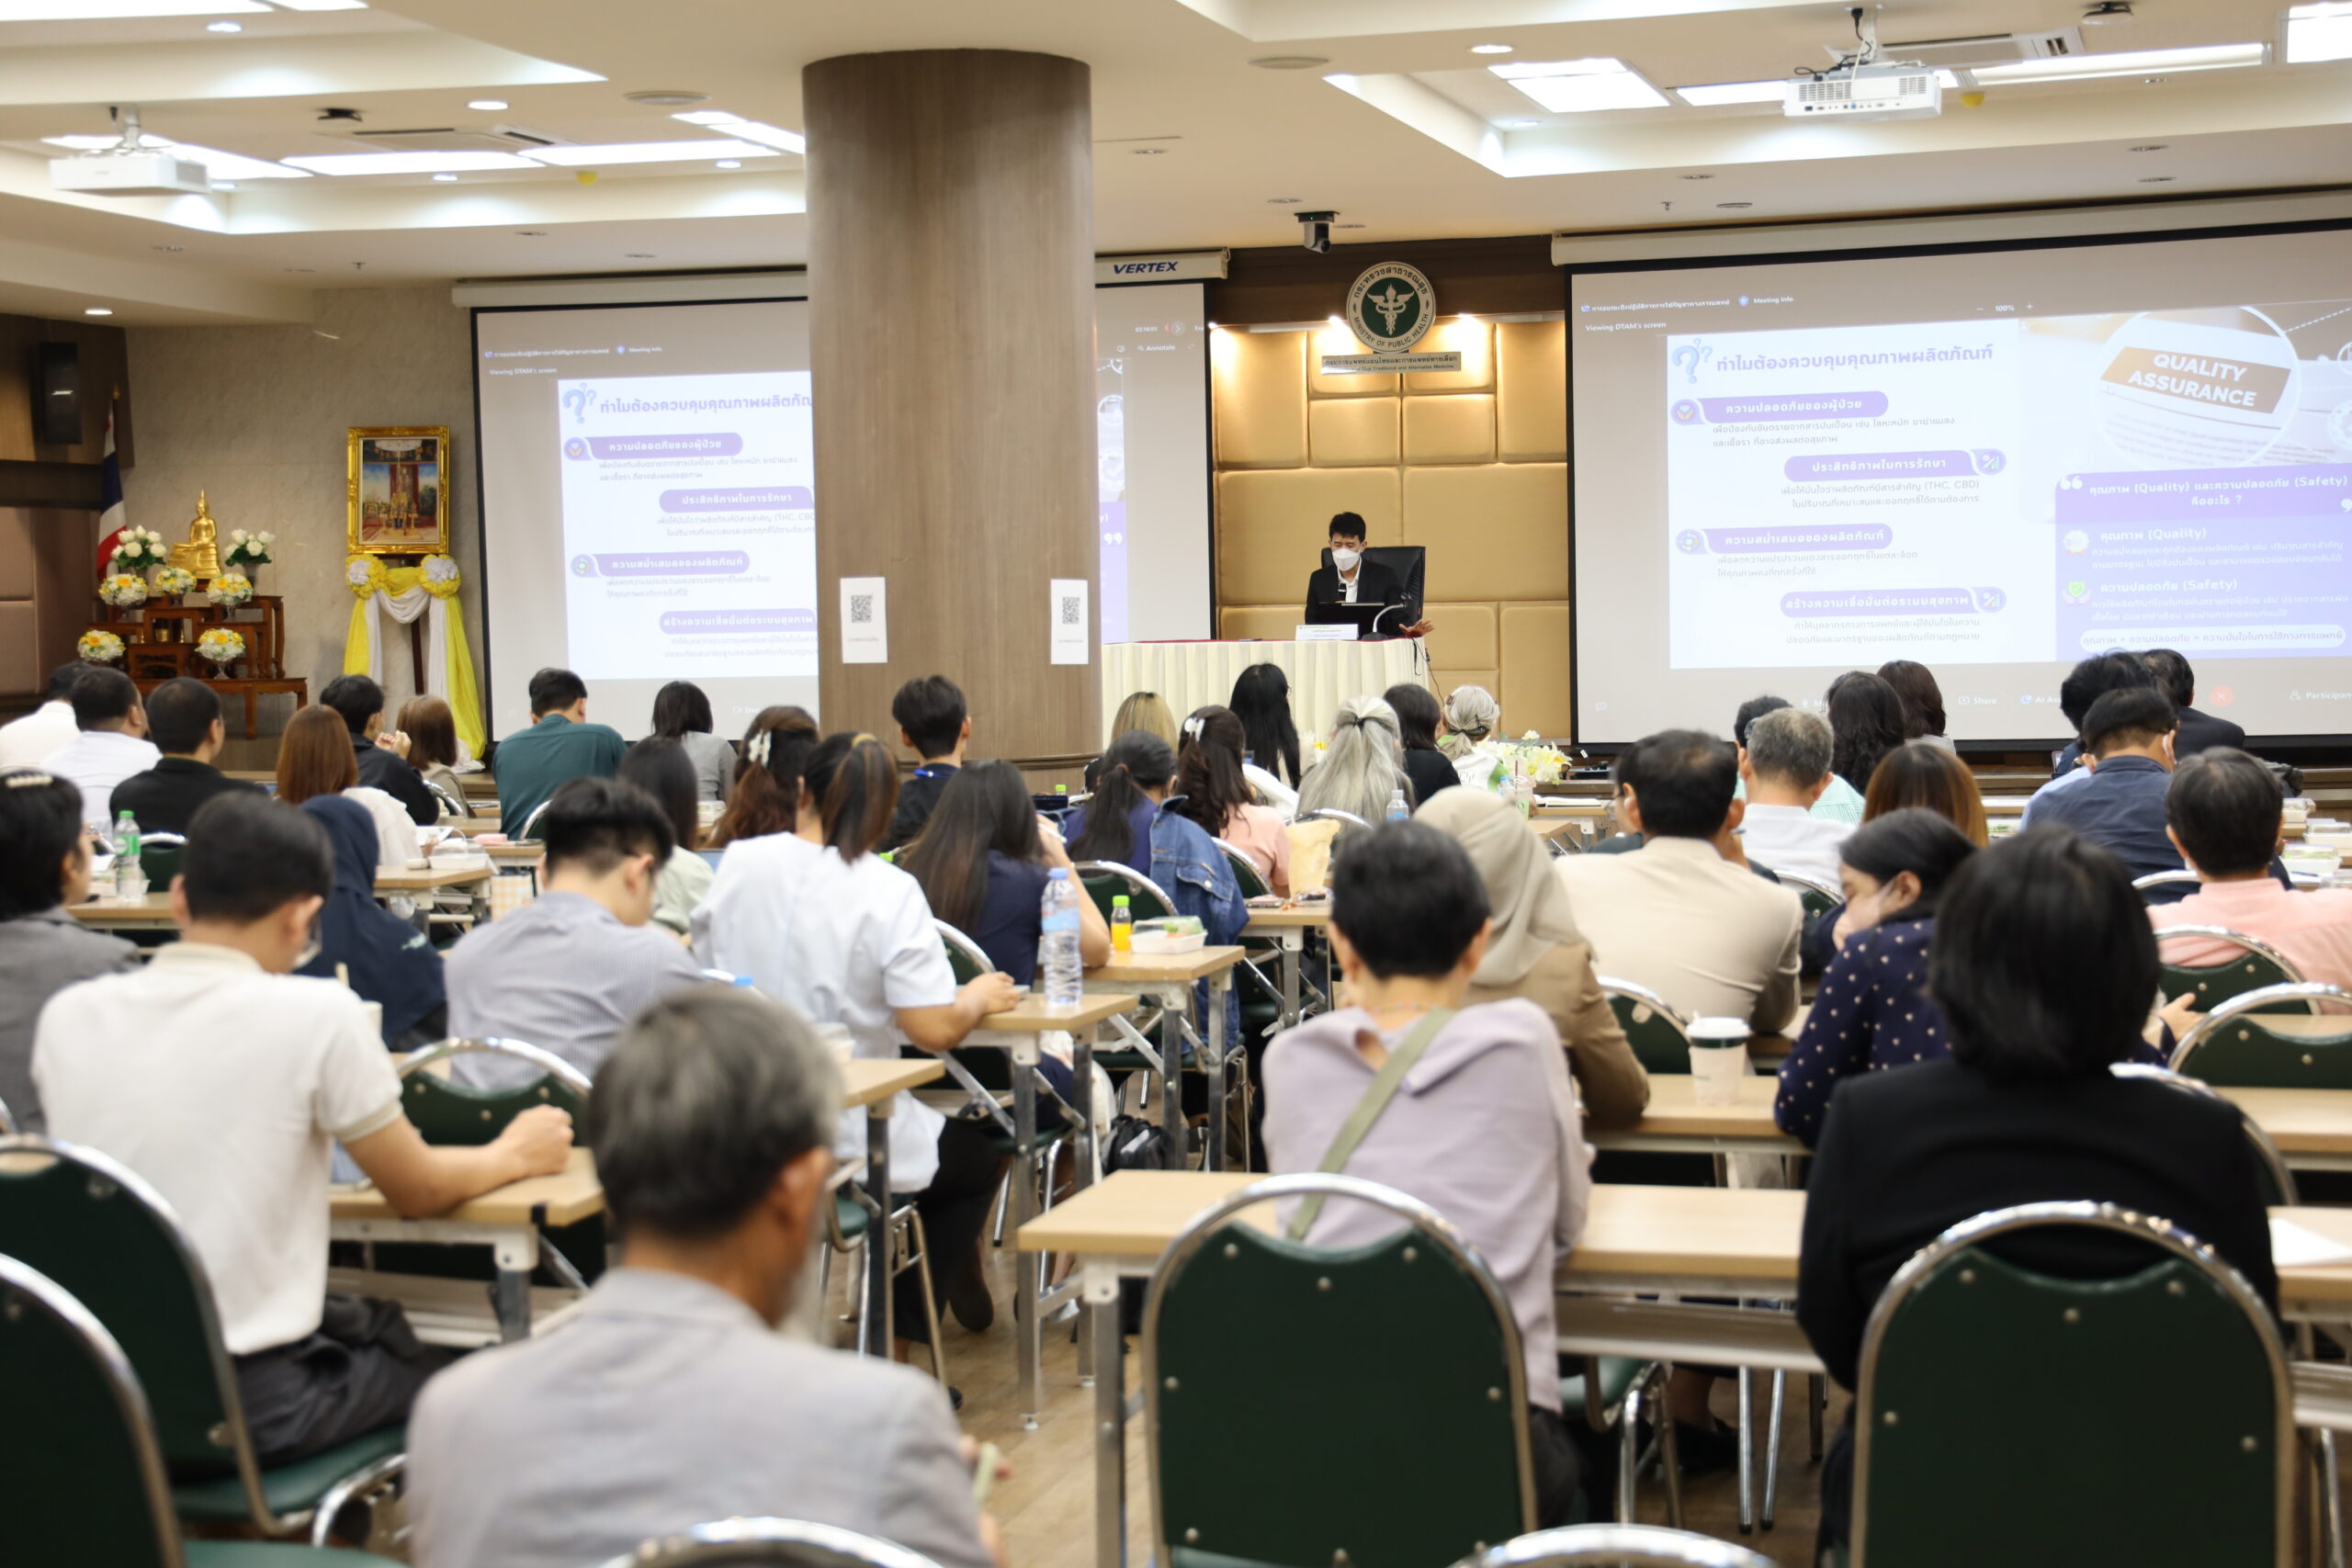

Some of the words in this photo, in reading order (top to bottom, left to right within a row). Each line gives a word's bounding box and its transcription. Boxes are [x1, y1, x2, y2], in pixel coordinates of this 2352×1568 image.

[1114, 261, 1179, 275] VERTEX
[1353, 266, 1429, 299] กระทรวงสาธารณสุข
[1753, 296, 1779, 306] Meeting
[1780, 295, 1794, 304] Info
[1995, 304, 2015, 313] 100%
[1353, 317, 1375, 343] MINISTRY
[1387, 337, 1411, 348] PUBLIC
[1412, 313, 1429, 339] HEALTH
[1585, 322, 1614, 333] Viewing
[1615, 321, 1642, 331] DTAM's
[1644, 321, 1667, 330] screen
[1716, 344, 1995, 372] ทำไมต้องควบคุมคุณภาพผลิตภัณฑ์
[2153, 353, 2248, 382] QUALITY
[2127, 369, 2257, 407] ASSURANCE
[1725, 398, 1862, 414] ความปลอดภัยของผู้ป่วย
[1812, 458, 1947, 473] ประสิทธิภาพในการรักษา
[1924, 479, 1951, 492] (THC,
[1954, 479, 1980, 491] CBD)
[2134, 481, 2190, 494] (Quality)
[2294, 474, 2347, 488] (Safety)
[2234, 494, 2243, 504] ?
[1724, 529, 1885, 546] ความสม่ำเสมอของผลิตภัณฑ์
[2147, 527, 2207, 541] (Quality)
[2182, 578, 2238, 592] (Safety)
[1972, 695, 1998, 705] Share
[2035, 695, 2045, 705] AI
